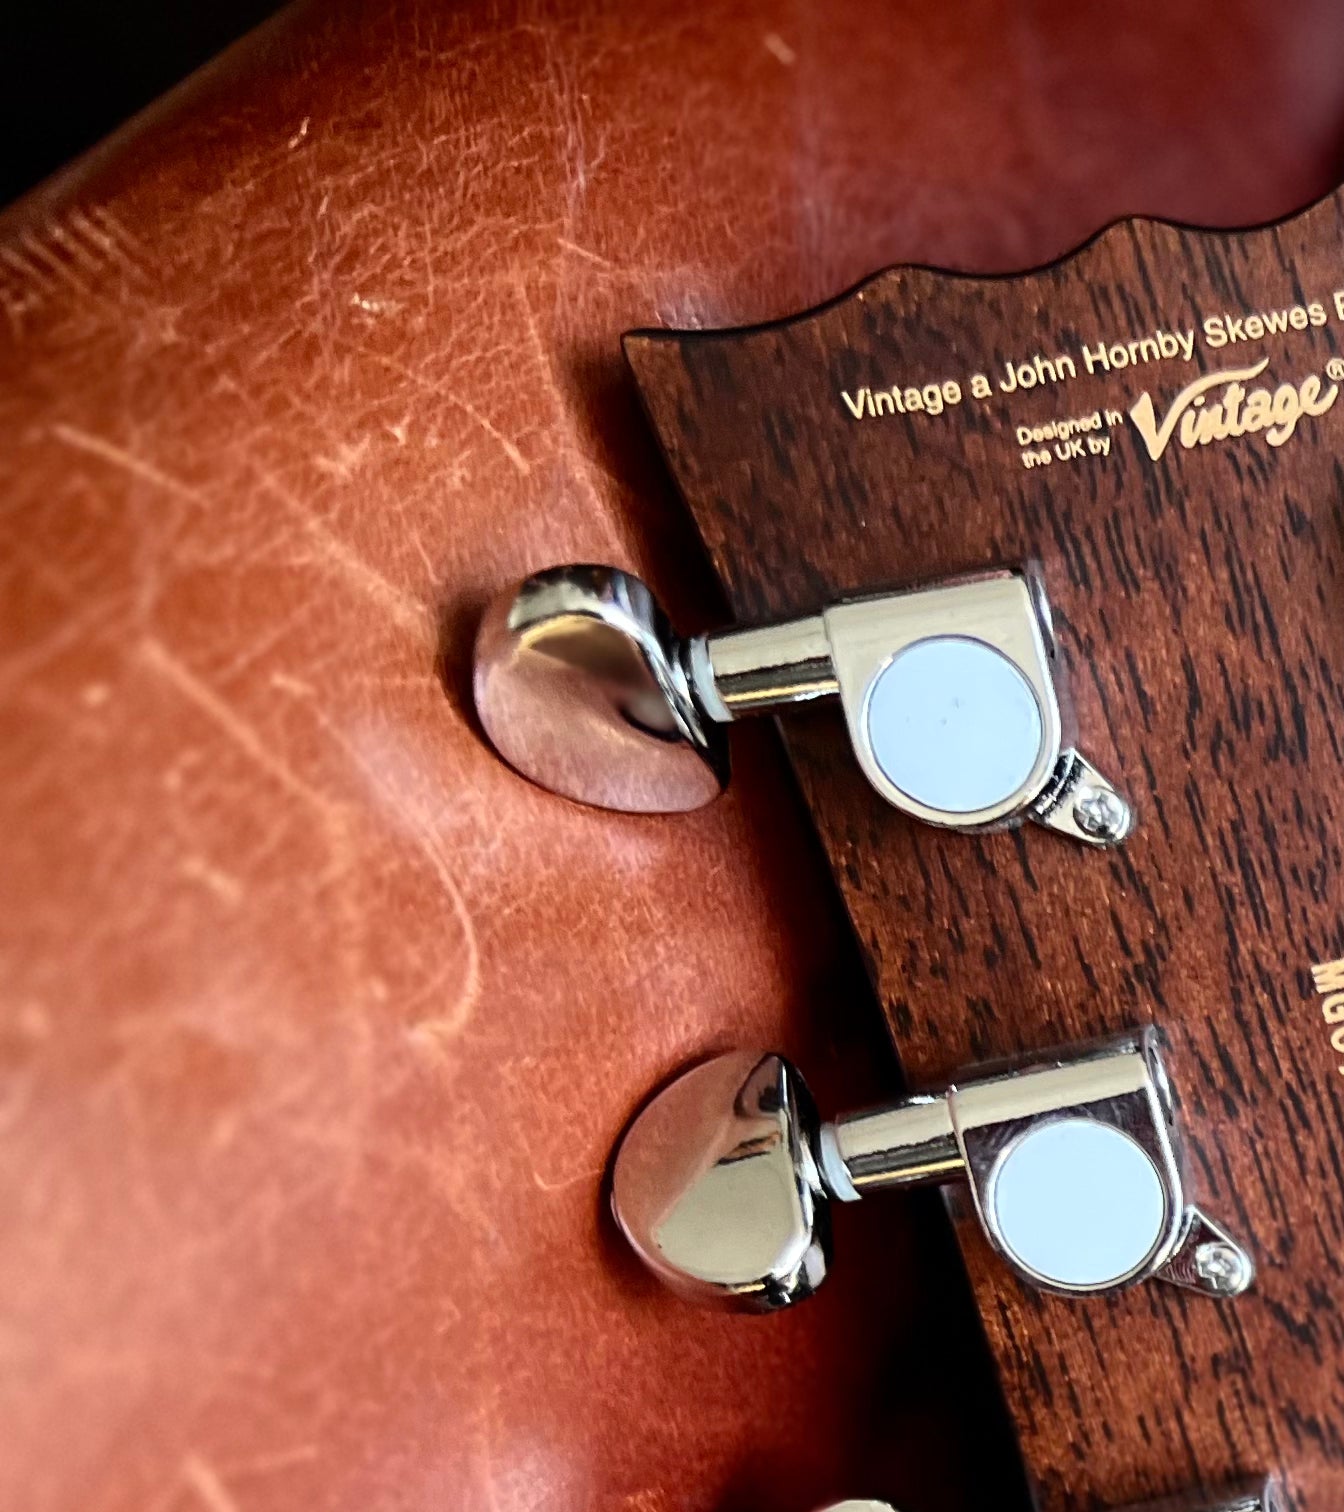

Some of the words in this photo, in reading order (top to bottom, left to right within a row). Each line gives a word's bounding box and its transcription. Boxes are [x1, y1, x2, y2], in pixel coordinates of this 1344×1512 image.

[841, 380, 963, 420] Vintage
[970, 374, 993, 399] a
[999, 354, 1077, 393] John
[1081, 327, 1195, 375] Hornby
[1203, 300, 1328, 348] Skewes
[1015, 411, 1103, 446] Designed
[1104, 408, 1124, 427] in
[1021, 448, 1052, 469] the
[1054, 438, 1087, 461] UK
[1086, 434, 1111, 457] by
